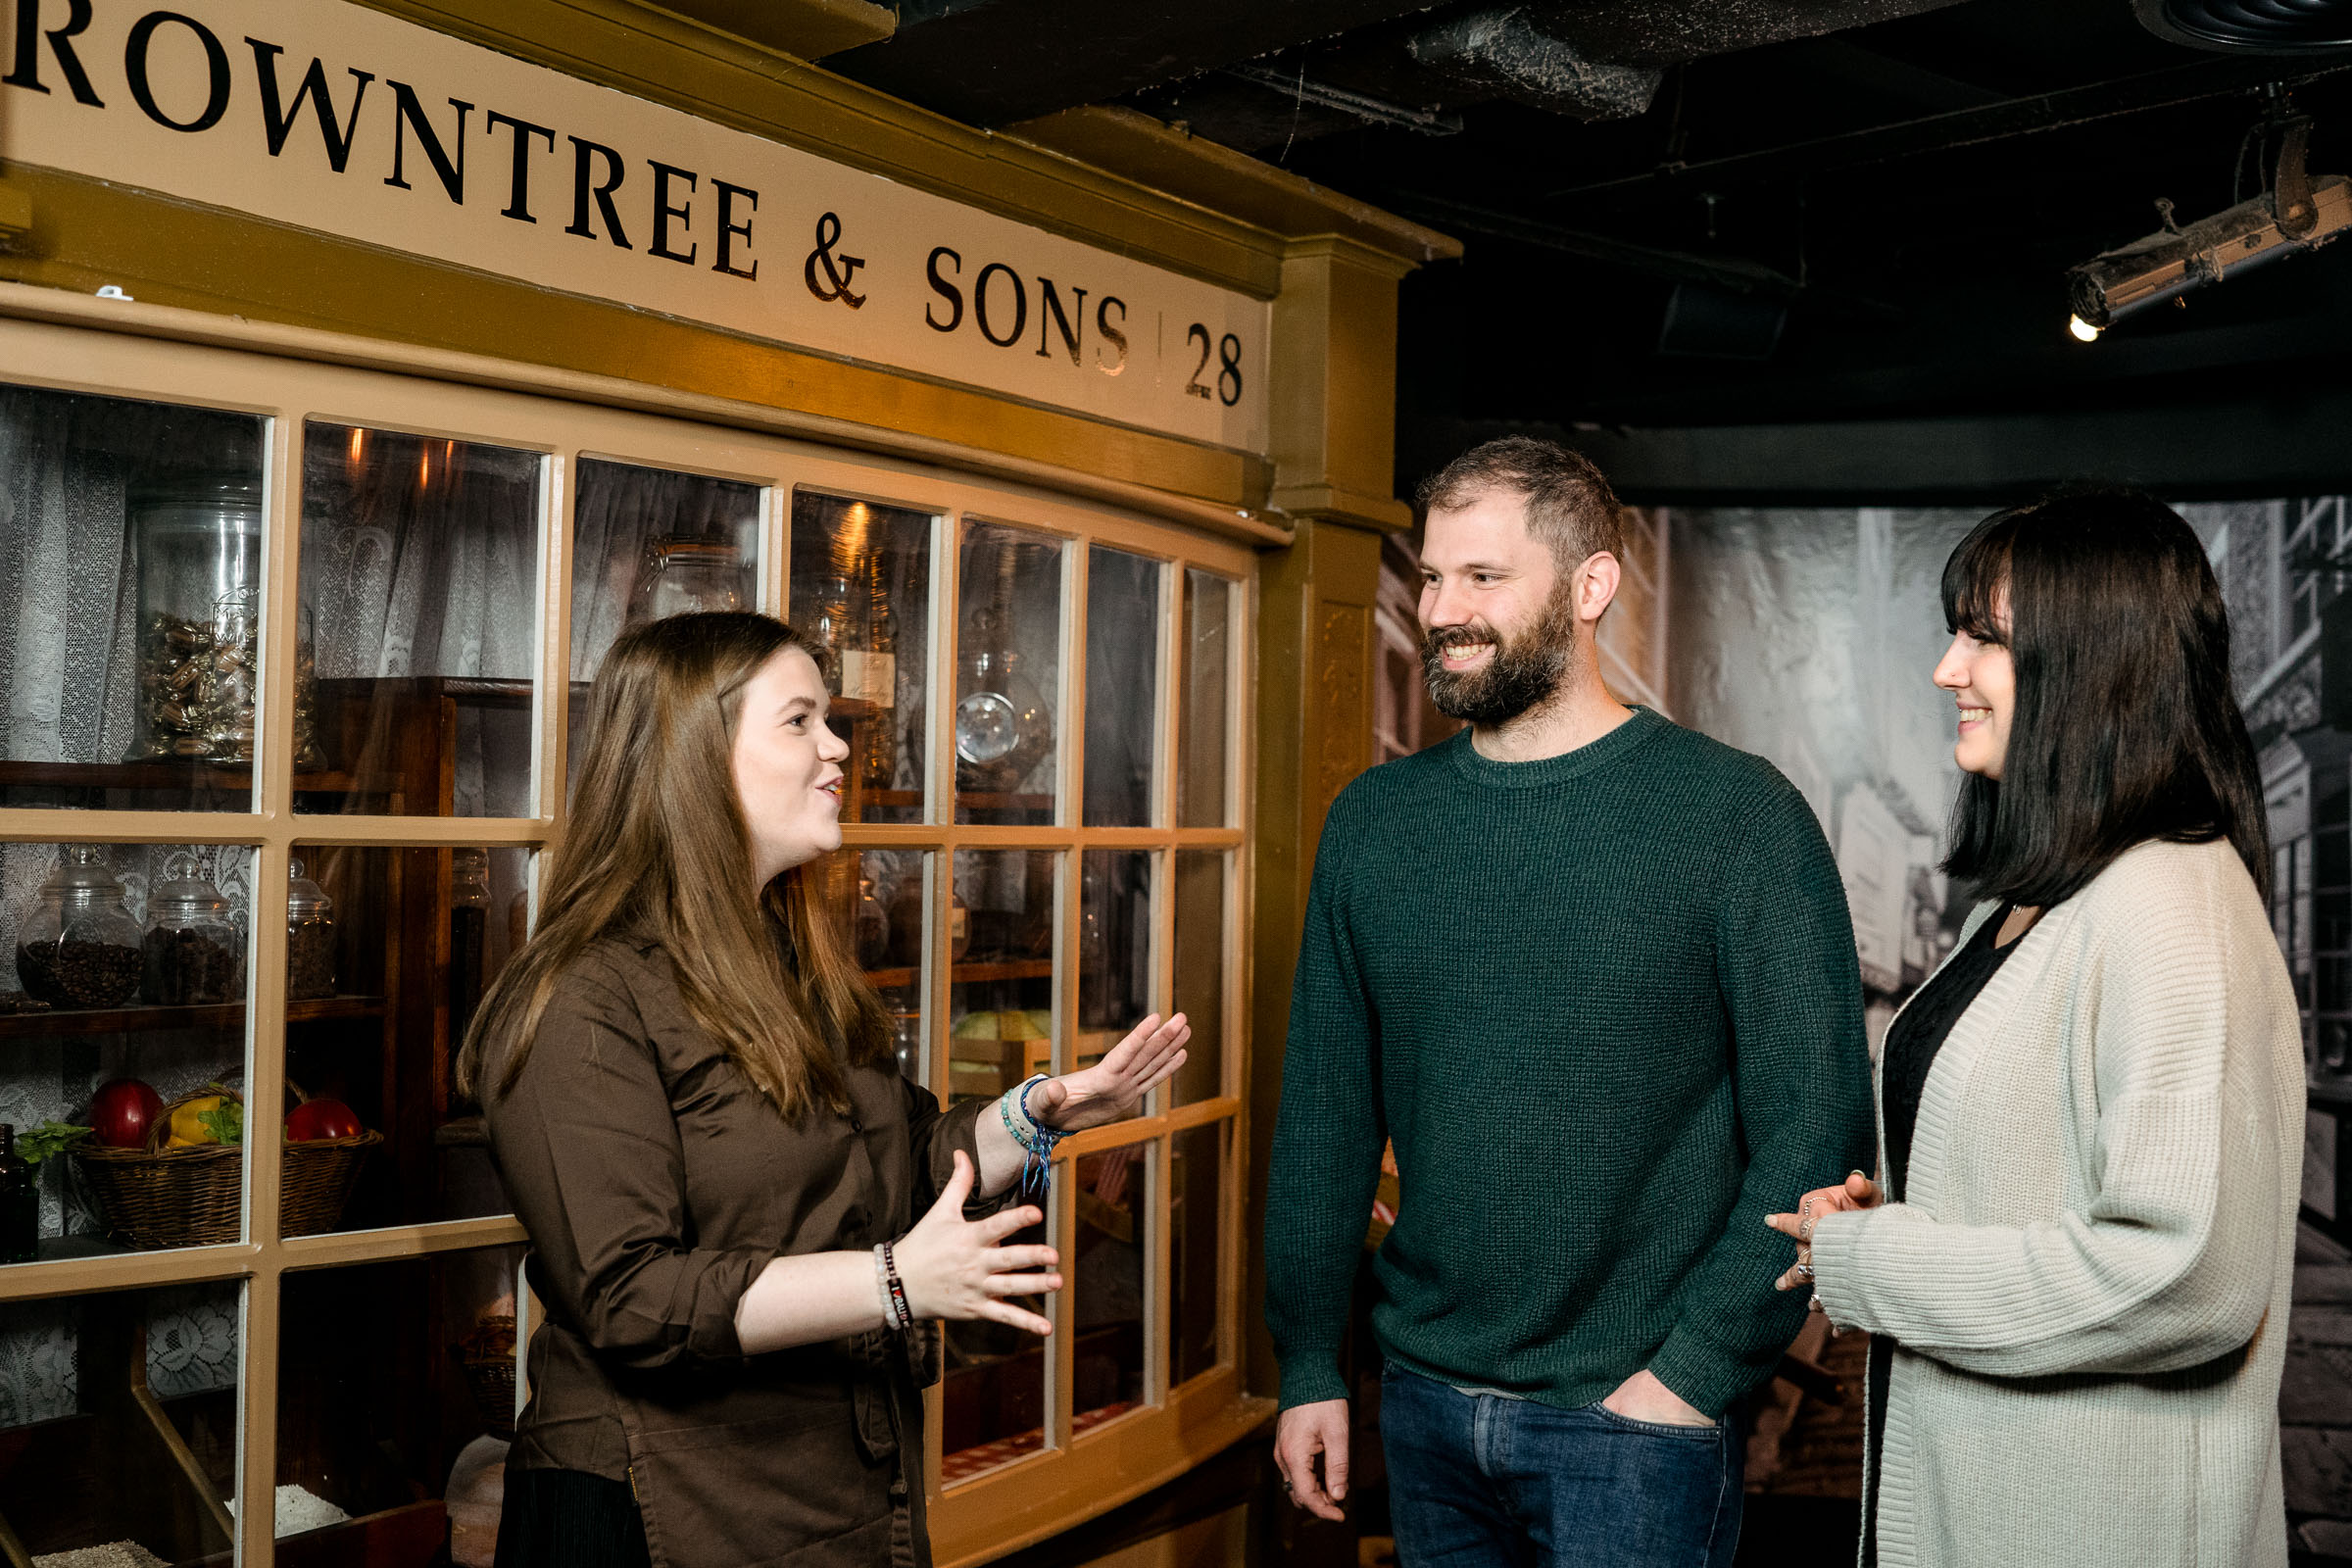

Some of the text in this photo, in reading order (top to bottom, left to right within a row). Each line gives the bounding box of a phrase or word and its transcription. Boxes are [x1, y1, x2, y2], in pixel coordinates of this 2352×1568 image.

[1, 0, 1128, 376] ROWNTREE & SONS
[1186, 322, 1243, 408] 28
